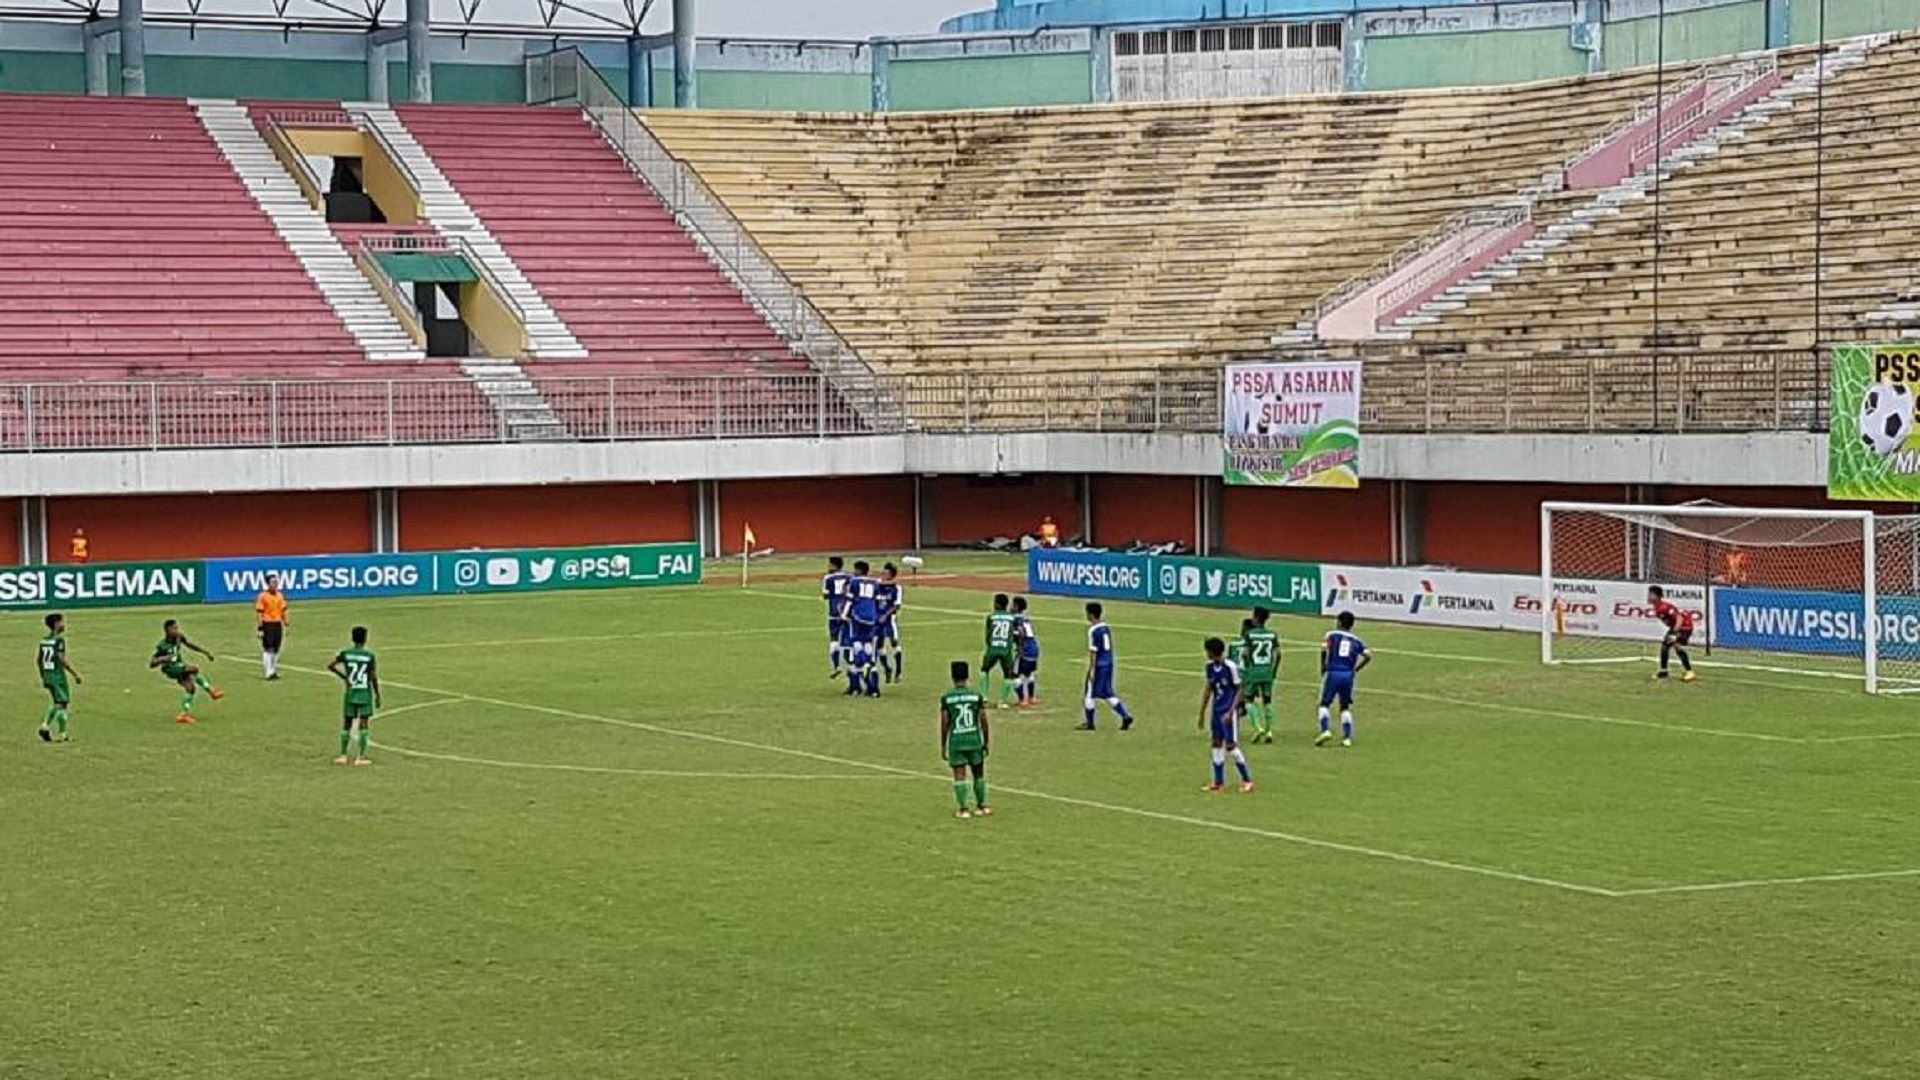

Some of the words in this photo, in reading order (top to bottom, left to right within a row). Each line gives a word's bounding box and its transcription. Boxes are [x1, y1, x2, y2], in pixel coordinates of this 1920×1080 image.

[1232, 371, 1276, 393] PSSA
[1281, 370, 1354, 393] ASAHAN
[1261, 403, 1323, 424] SUMUT
[54, 567, 195, 598] SLEMAN
[223, 564, 418, 592] WWW.PSSI.ORG
[1037, 560, 1141, 589] WWW.PSSI.ORG
[1352, 589, 1404, 605] PERTAMINA
[1437, 596, 1495, 611] PERTAMINA
[1252, 640, 1273, 659] 23
[954, 702, 974, 729] 26
